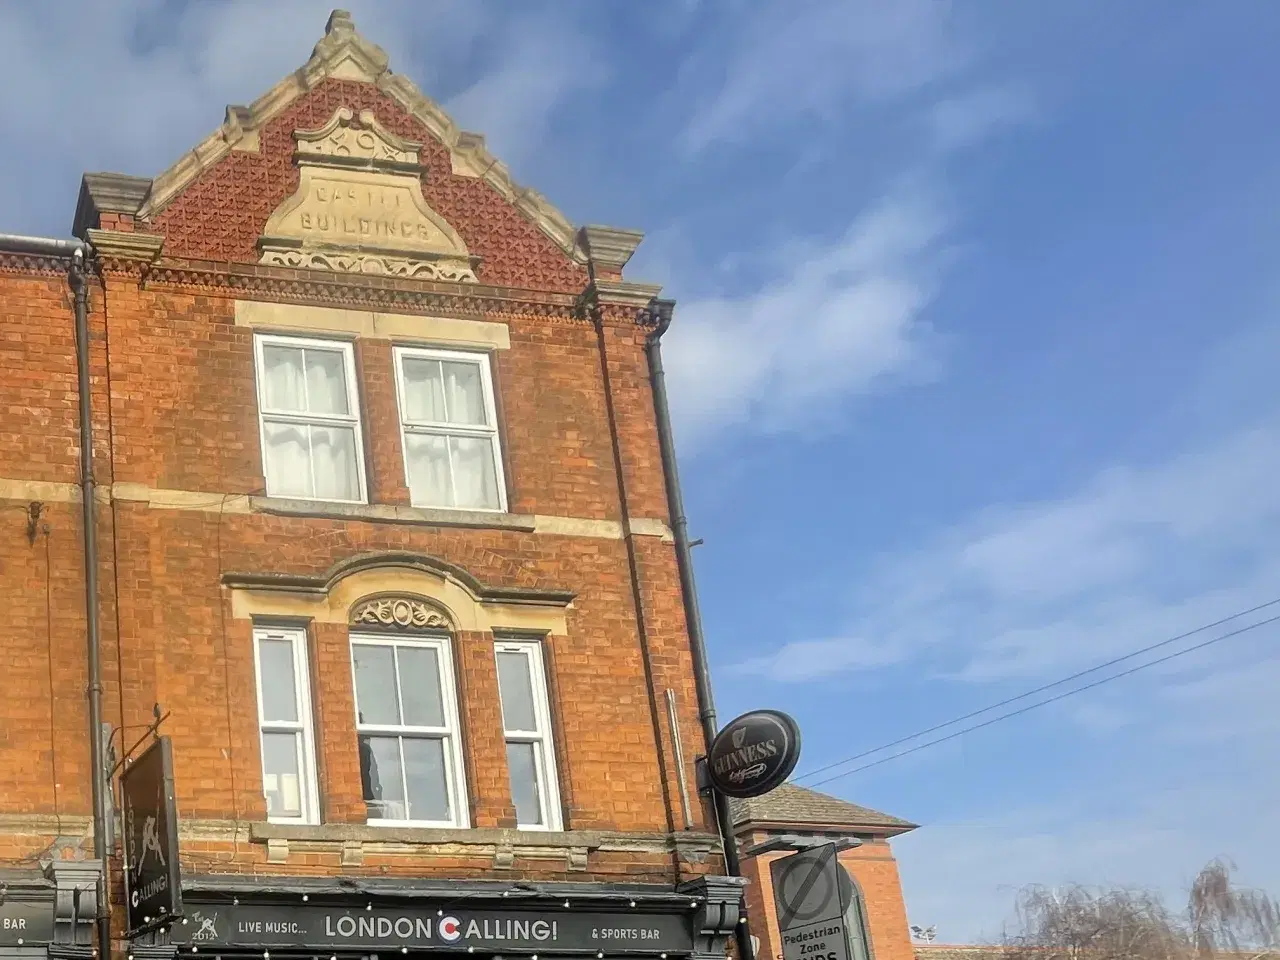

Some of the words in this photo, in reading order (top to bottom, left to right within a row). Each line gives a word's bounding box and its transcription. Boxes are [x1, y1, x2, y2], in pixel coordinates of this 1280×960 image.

[714, 739, 777, 774] GUINNESS
[132, 875, 168, 907] CALLING!
[5, 918, 27, 930] BAR
[238, 922, 262, 933] LIVE
[325, 915, 431, 938] LONDON
[437, 912, 558, 944] CALLING!
[192, 932, 215, 941] 2012
[591, 928, 600, 939] &
[602, 928, 637, 940] SPORTS
[640, 928, 660, 940] BAR
[783, 924, 841, 946] Pedestrian
[800, 942, 826, 955] Zone
